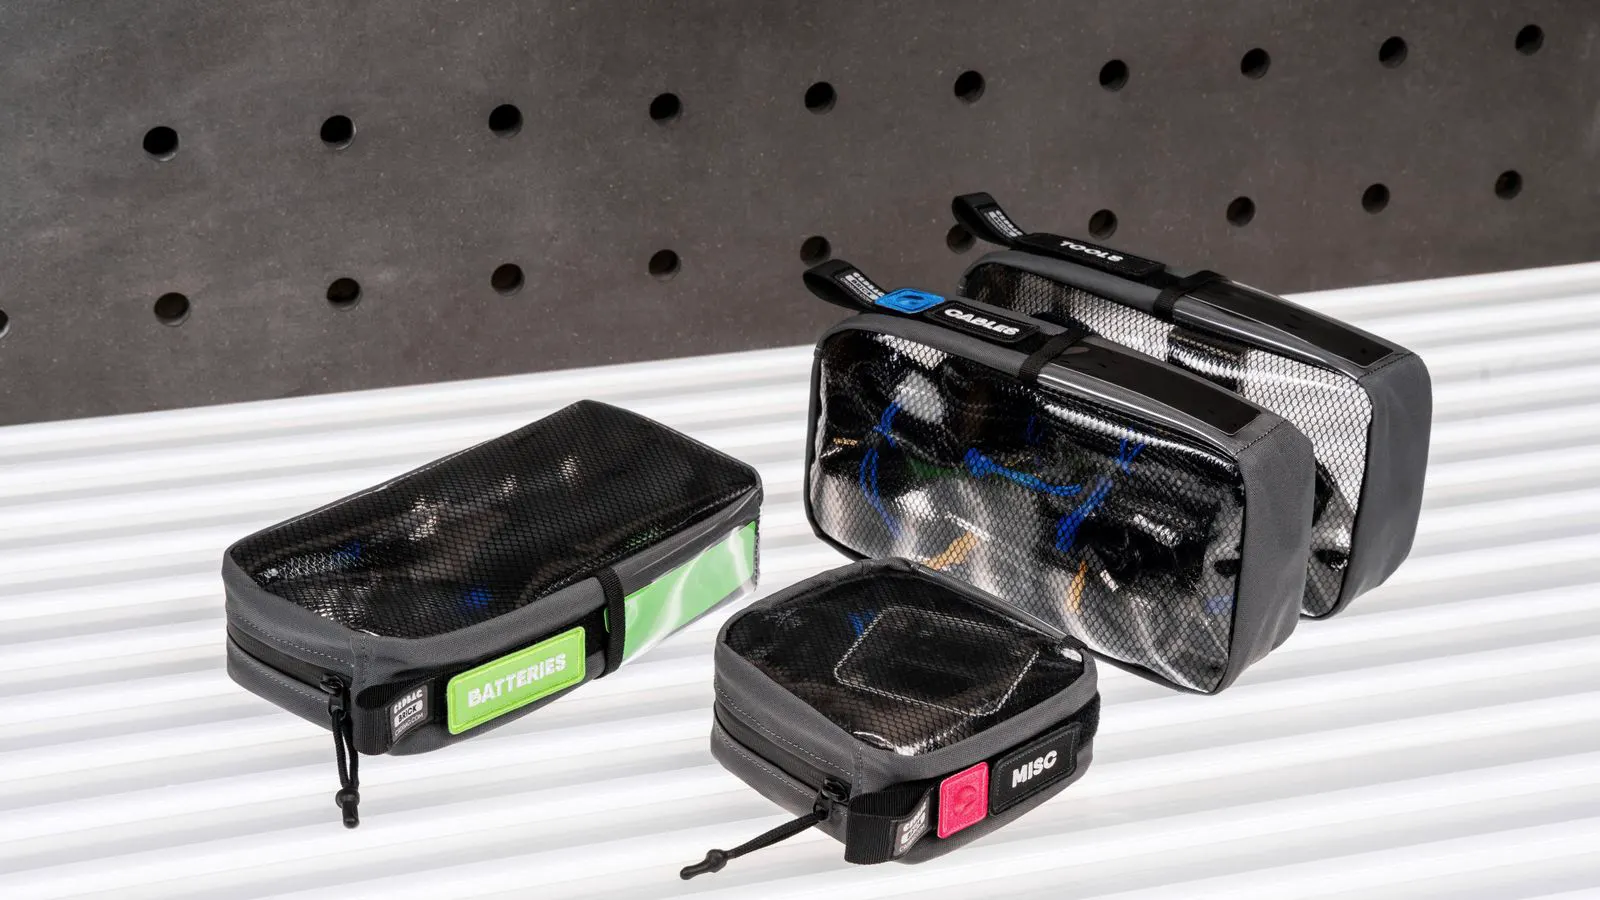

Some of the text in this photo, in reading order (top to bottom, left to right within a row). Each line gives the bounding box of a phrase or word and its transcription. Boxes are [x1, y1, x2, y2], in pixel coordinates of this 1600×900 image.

[1060, 240, 1124, 262] TOOLS
[944, 308, 1020, 336] CABLES
[468, 653, 566, 708] BATTERIES
[398, 704, 418, 723] BRICK
[1012, 750, 1058, 788] MISC
